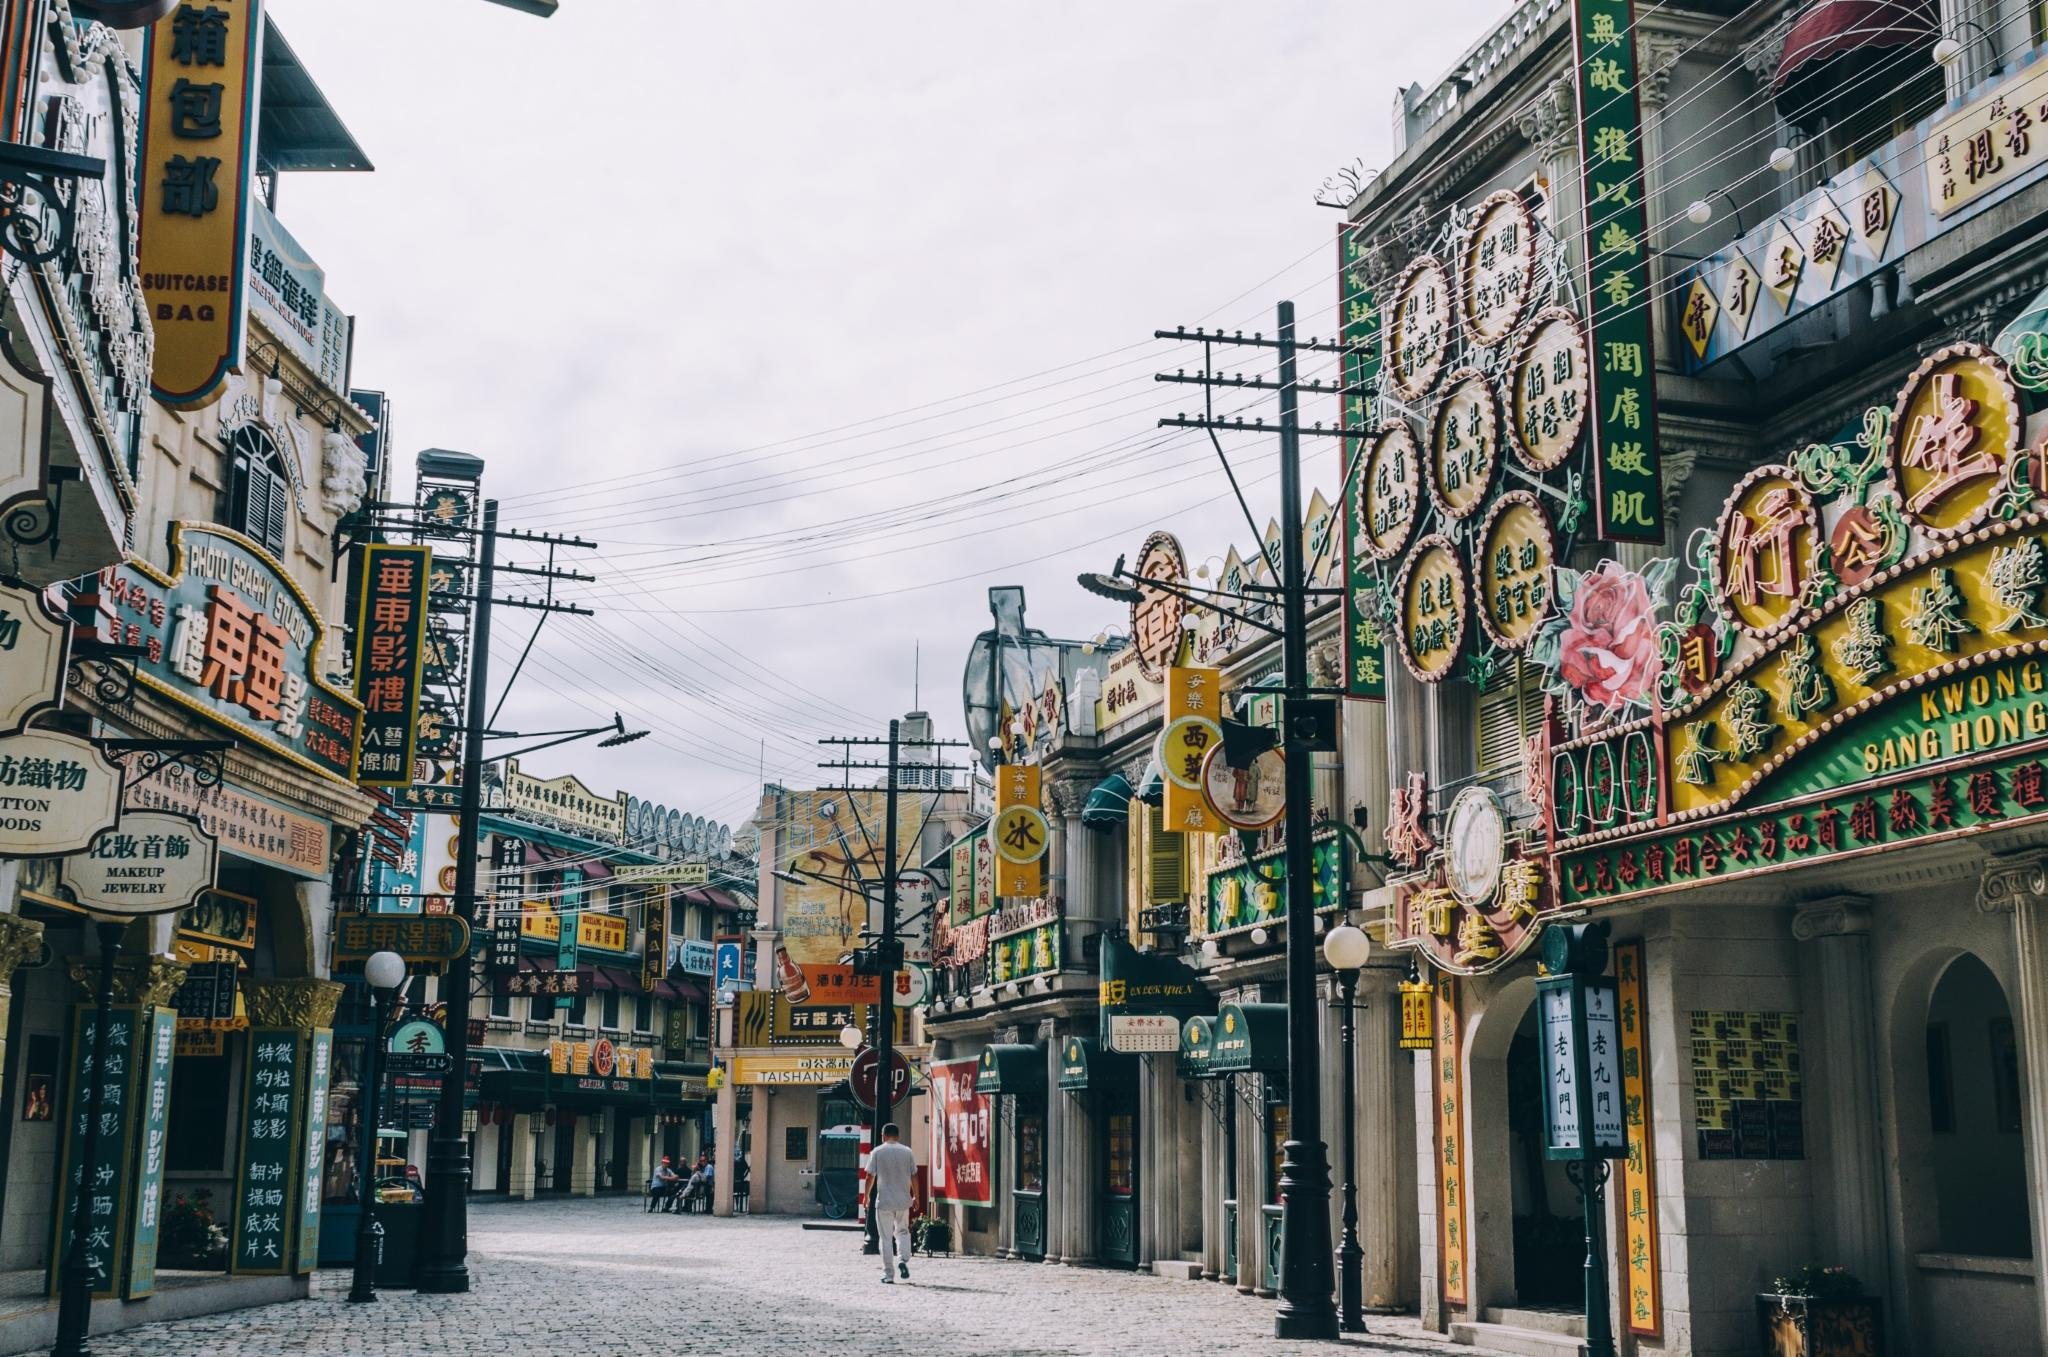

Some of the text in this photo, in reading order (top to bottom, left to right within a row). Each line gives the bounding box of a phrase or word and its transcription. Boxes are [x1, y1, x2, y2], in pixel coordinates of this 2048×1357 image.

[162, 0, 231, 217] 箱包部
[143, 273, 229, 292] SUITCASE
[156, 304, 215, 322] BAG
[189, 545, 309, 651] PHOTO GRAPHY STUDIO
[366, 558, 416, 713] 華東影樓
[1921, 661, 2043, 722] KWONG
[1864, 700, 2046, 774] SANG HONG
[101, 882, 167, 895] JEWELRY
[106, 866, 165, 879] MAKEUP
[761, 1071, 824, 1082] TAISHAN
[1553, 1031, 1572, 1116] 老九門
[1592, 1028, 1611, 1116] 老九門
